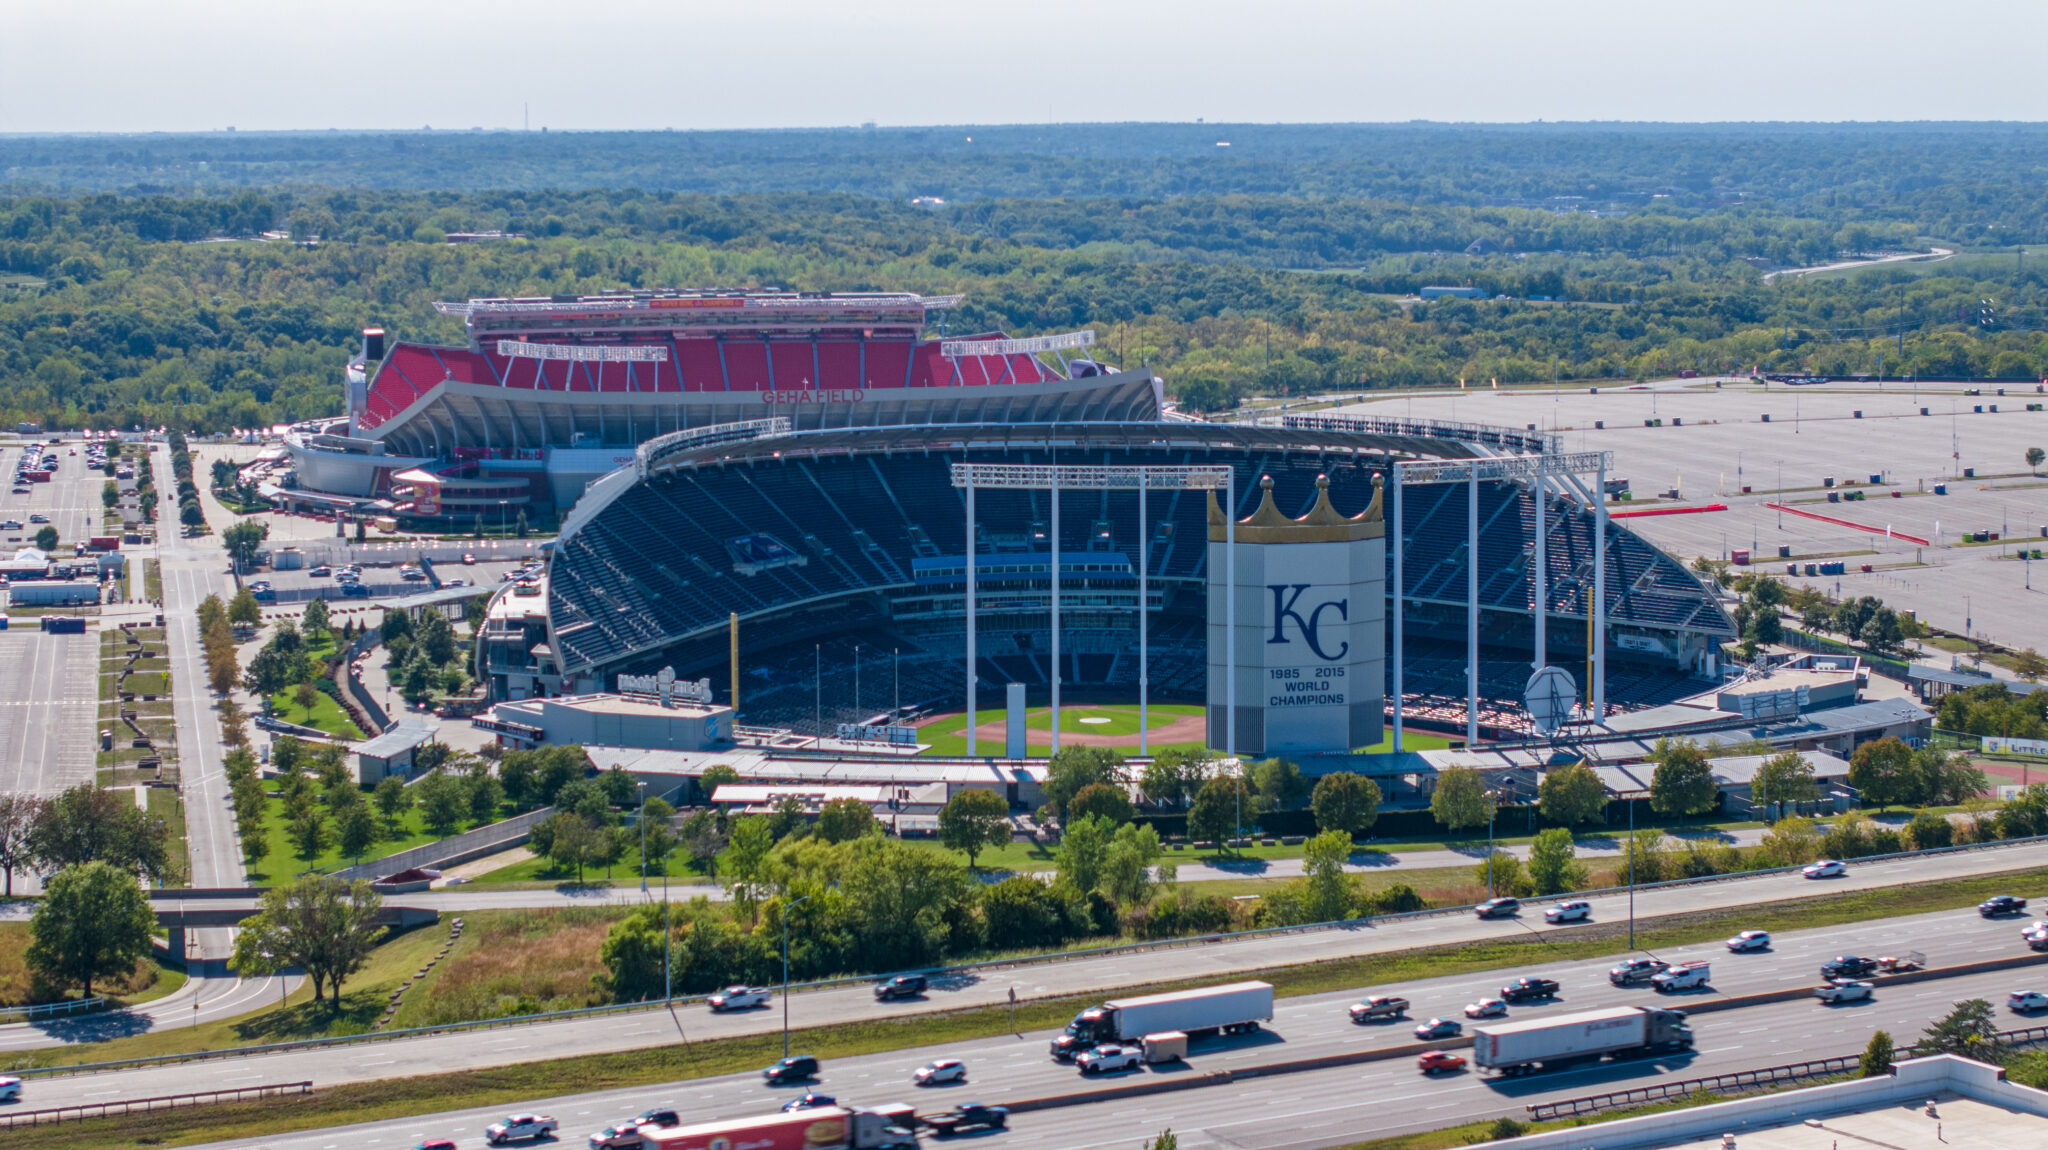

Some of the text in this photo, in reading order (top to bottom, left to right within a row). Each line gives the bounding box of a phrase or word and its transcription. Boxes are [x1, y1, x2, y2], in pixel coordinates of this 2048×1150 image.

[761, 388, 865, 405] GEHA FIELD
[1266, 584, 1349, 661] KC
[1270, 667, 1345, 679] 1985 2015
[1285, 681, 1330, 692] WORLD
[1270, 694, 1344, 706] CHAMPIONS
